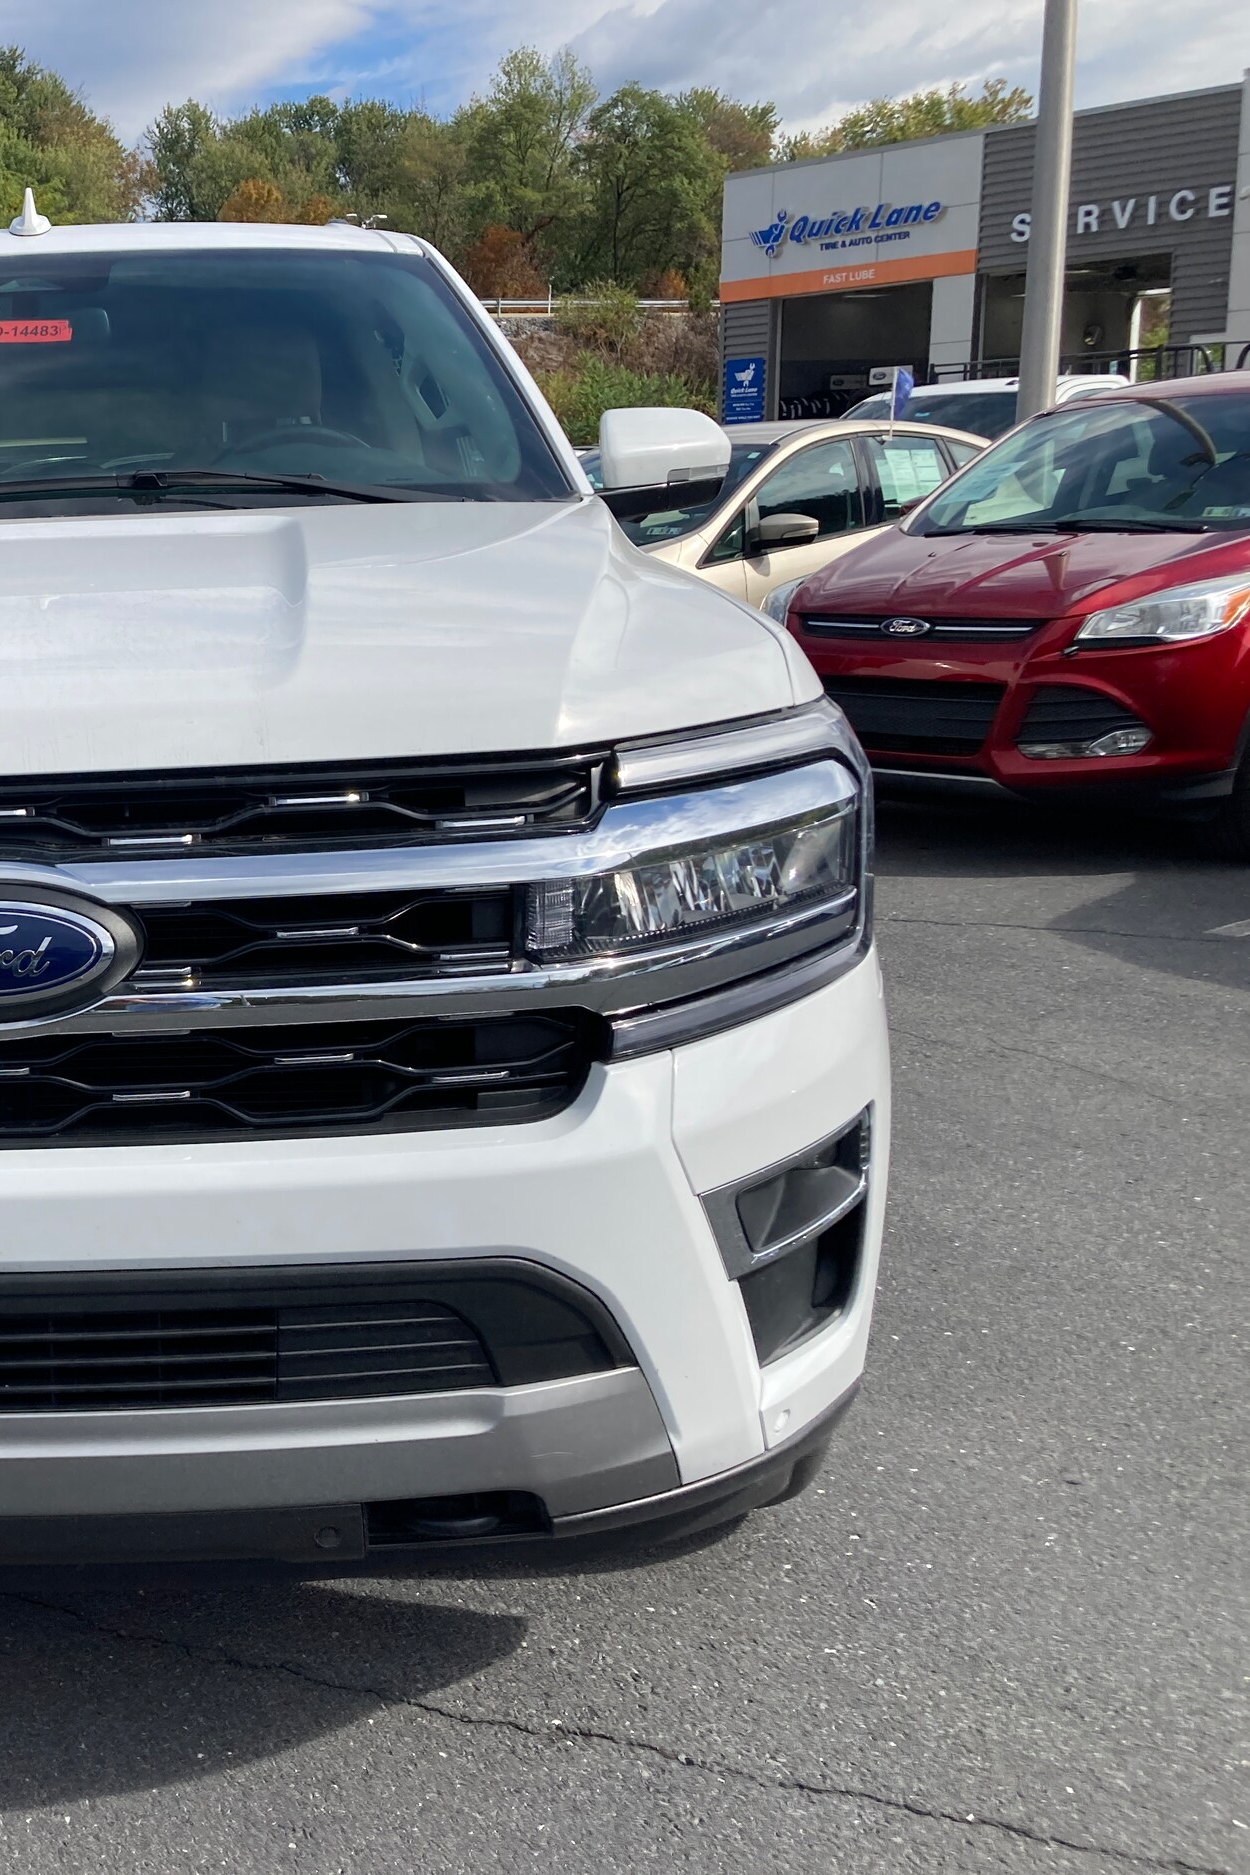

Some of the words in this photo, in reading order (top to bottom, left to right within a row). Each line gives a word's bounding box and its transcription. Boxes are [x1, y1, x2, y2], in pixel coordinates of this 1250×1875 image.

[789, 206, 867, 244] Quick
[868, 201, 942, 231] Lane
[1010, 185, 1232, 243] SRVICE
[819, 241, 839, 251] TIRE
[840, 239, 847, 248] &
[848, 236, 873, 247] AUTO
[874, 231, 911, 243] CENTER
[823, 272, 848, 284] FAST
[849, 268, 876, 281] LUBE
[889, 619, 917, 633] Ford
